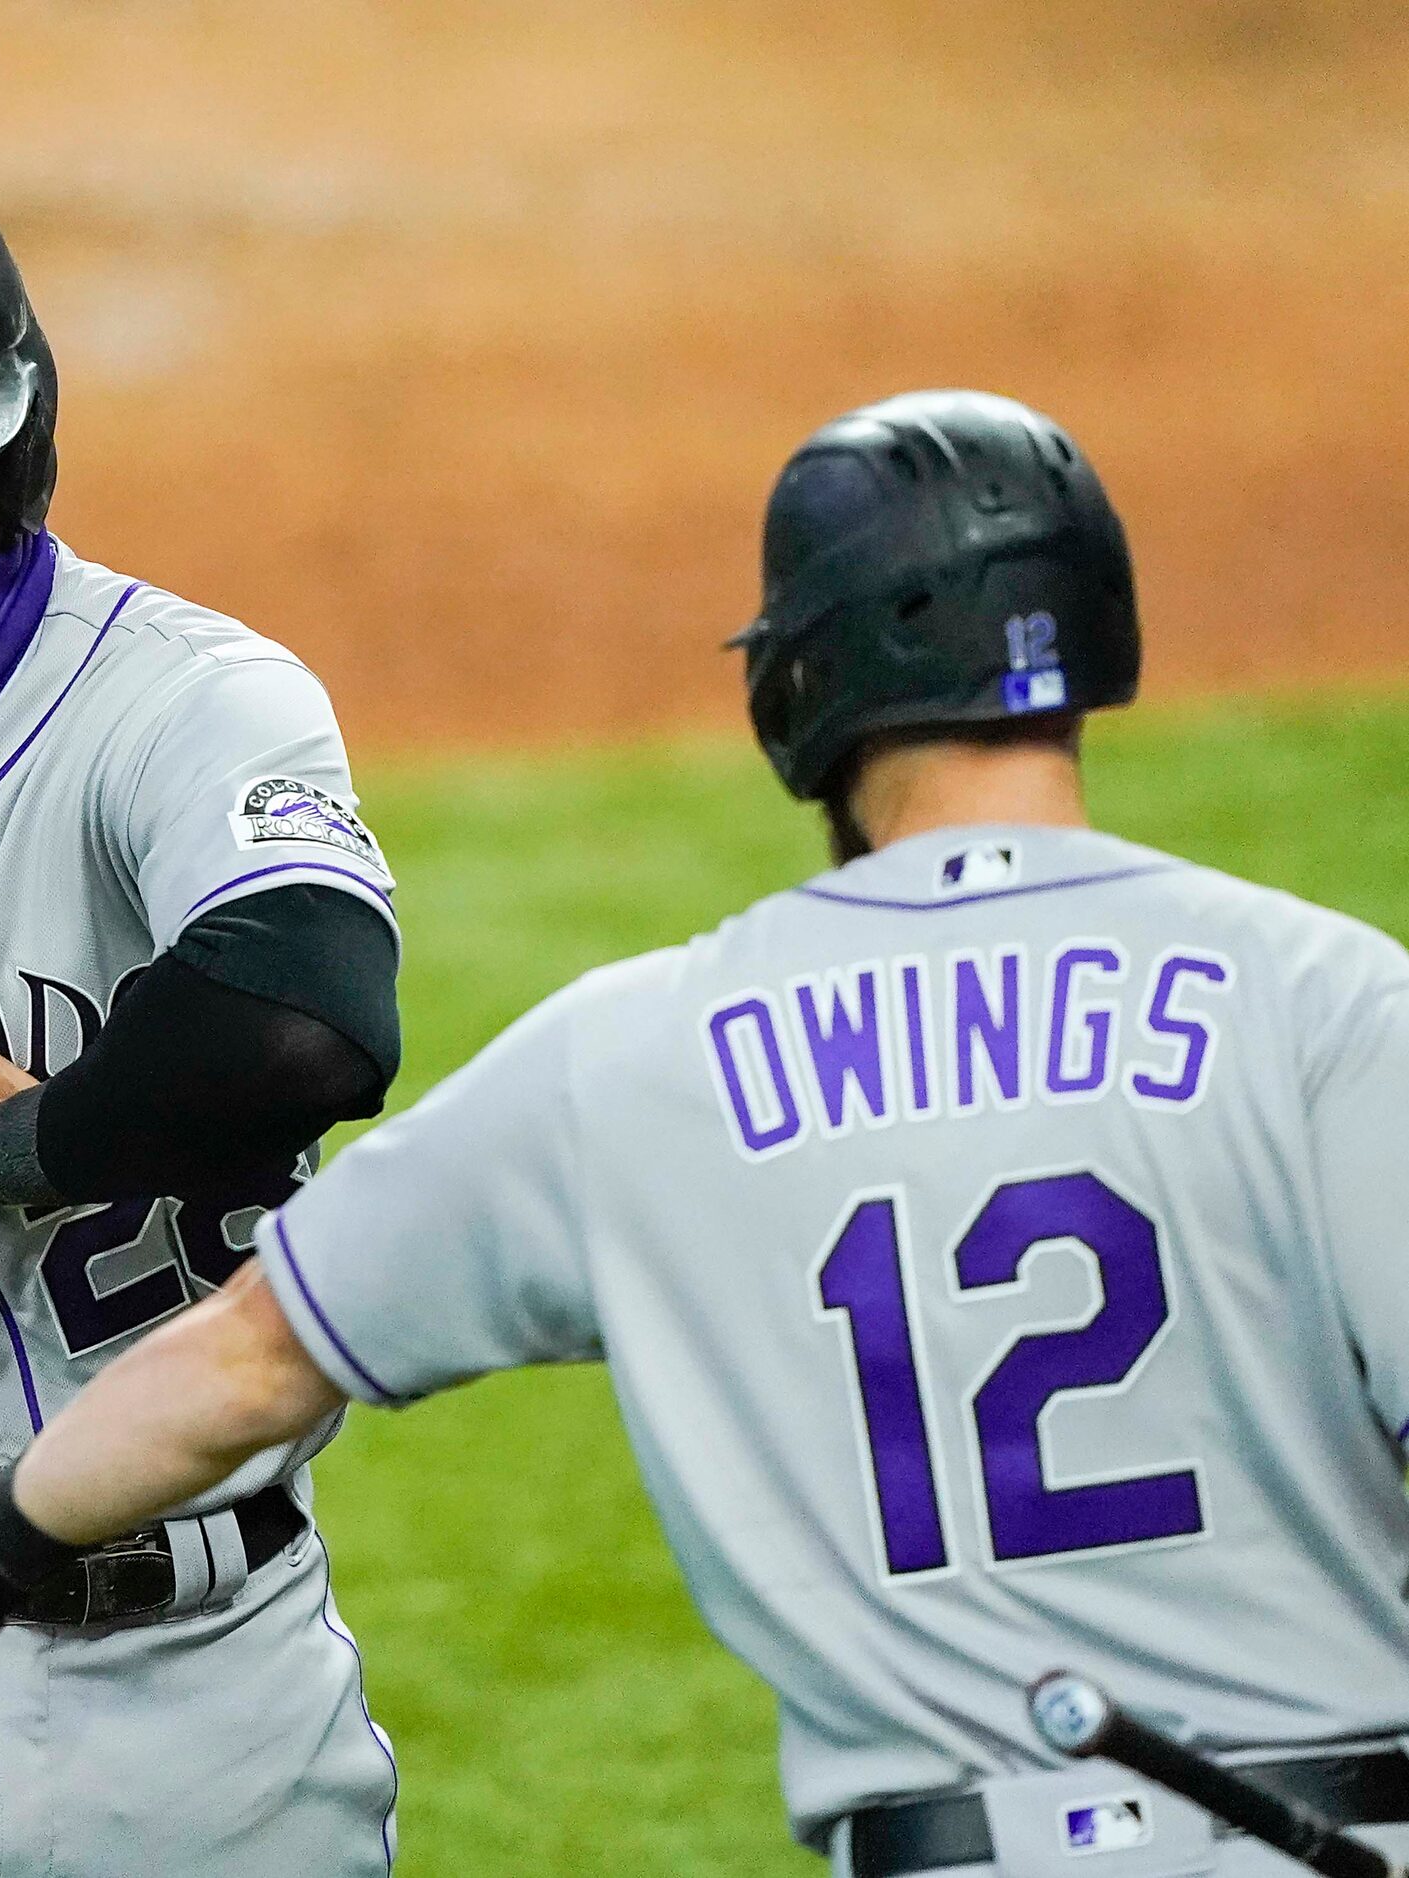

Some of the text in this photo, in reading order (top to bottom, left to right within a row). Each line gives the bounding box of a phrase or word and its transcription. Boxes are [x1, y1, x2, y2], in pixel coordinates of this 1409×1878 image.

[1004, 611, 1059, 670] 12
[704, 942, 1231, 1157] OWINGS
[813, 1165, 1209, 1581] 12
